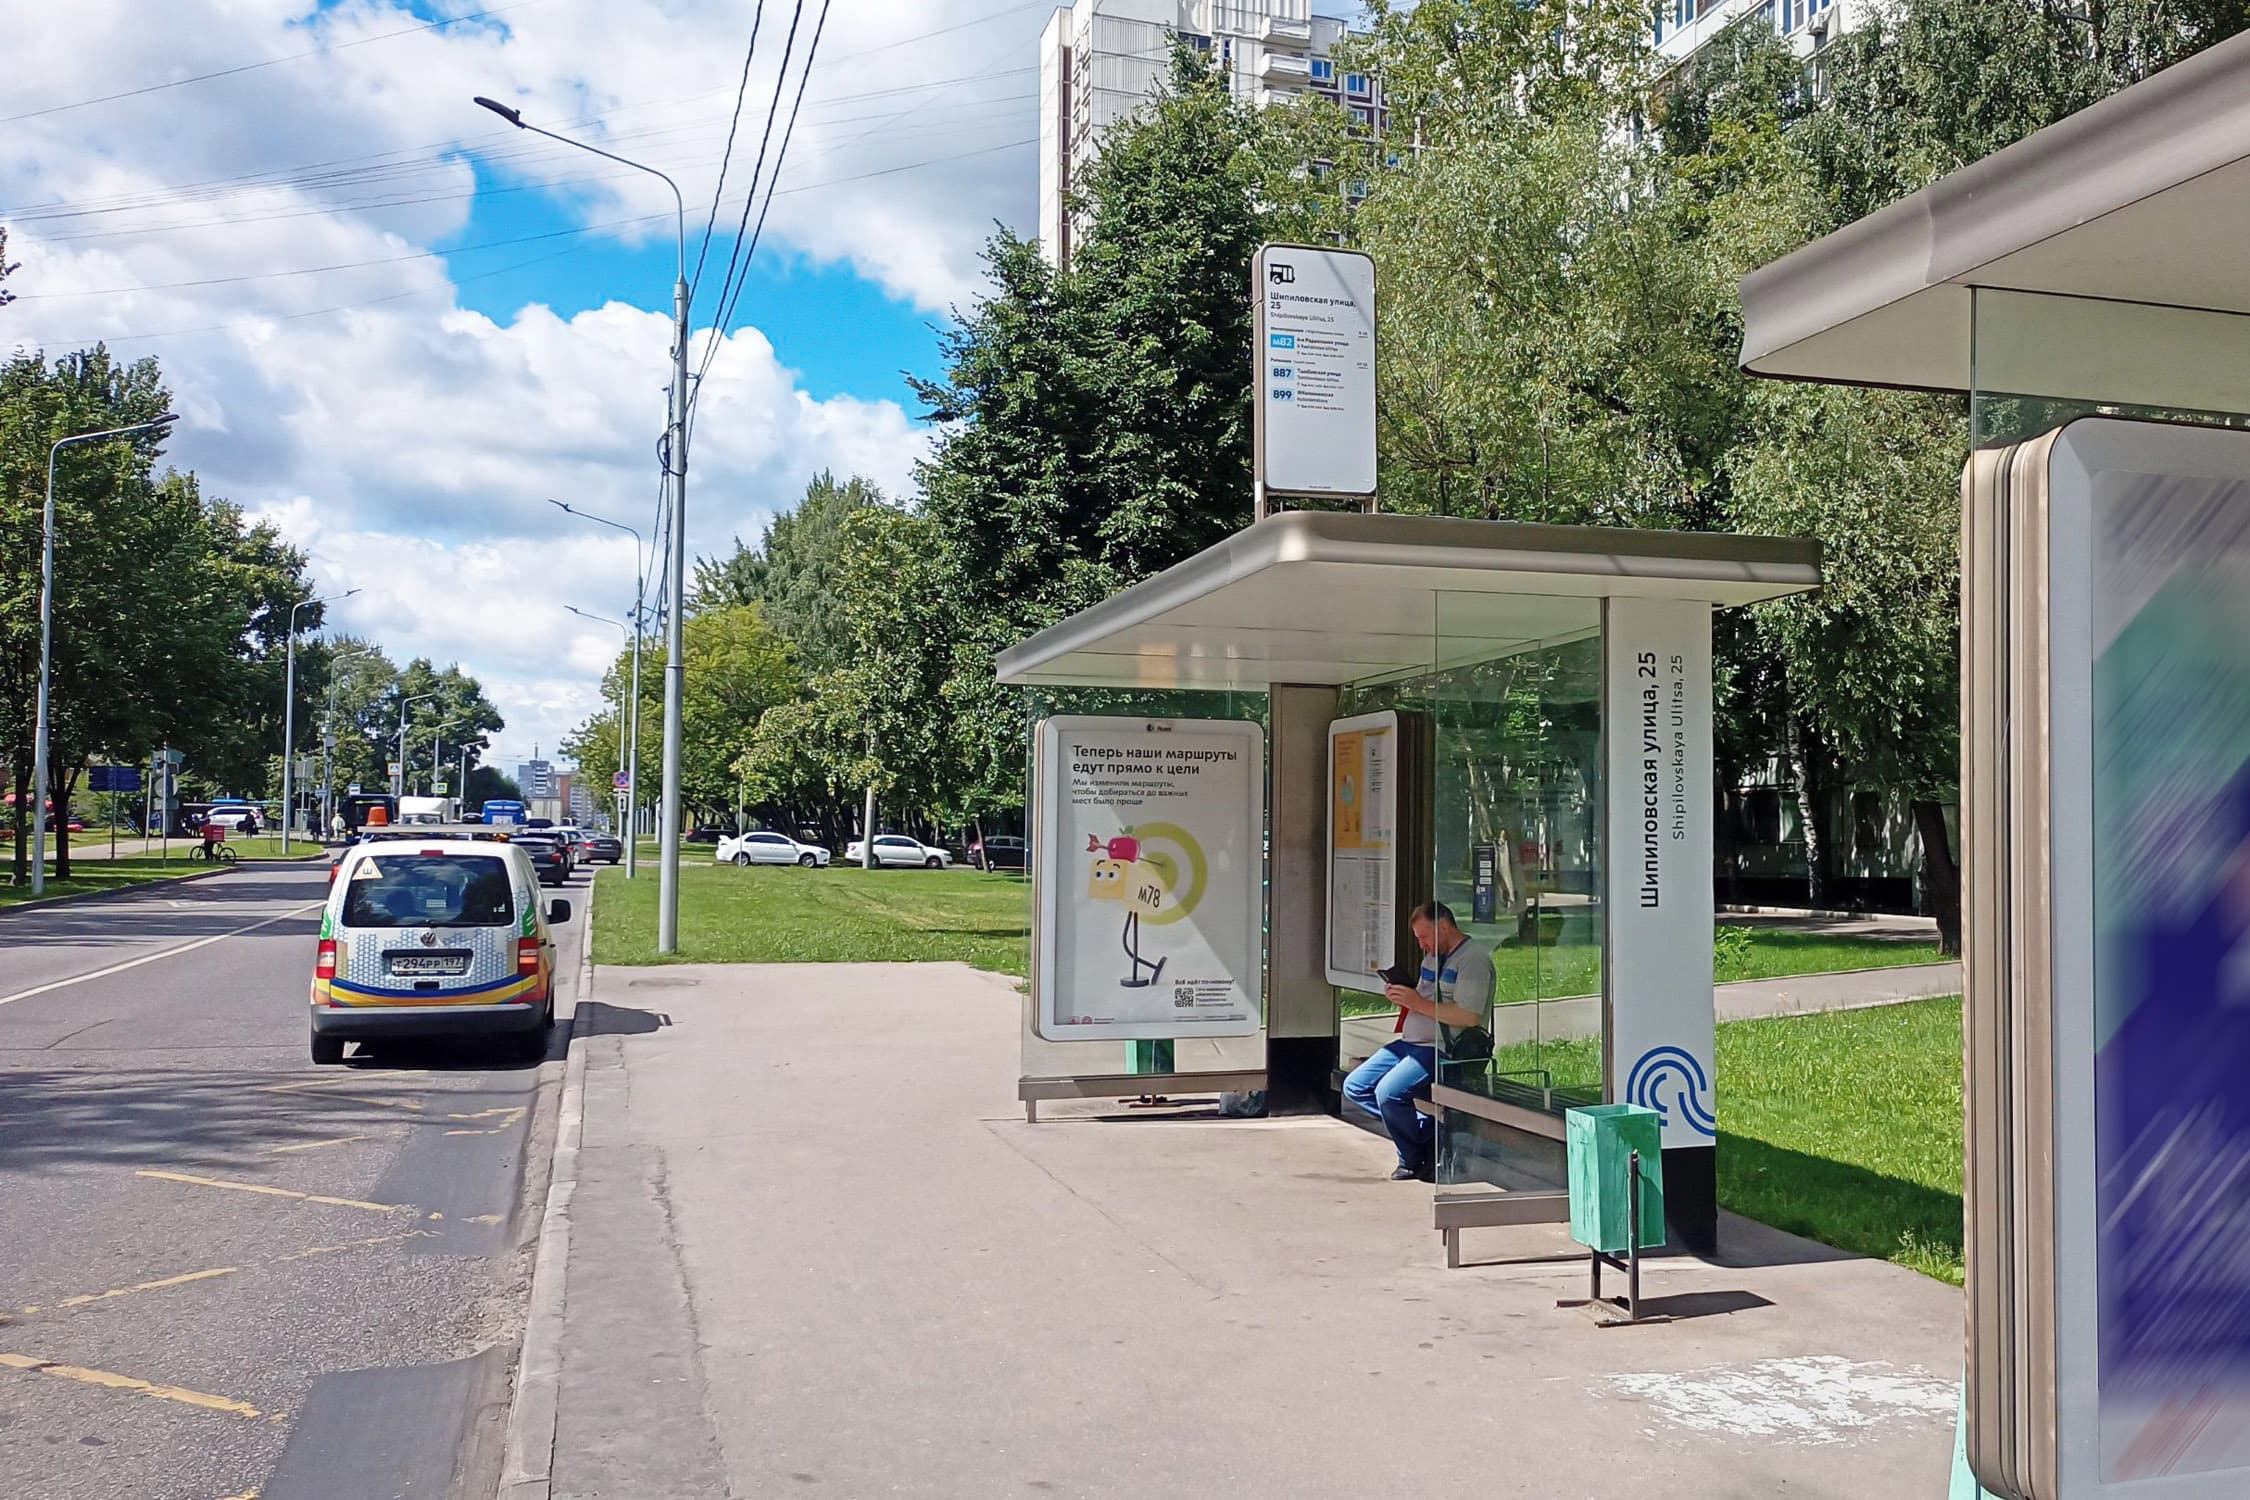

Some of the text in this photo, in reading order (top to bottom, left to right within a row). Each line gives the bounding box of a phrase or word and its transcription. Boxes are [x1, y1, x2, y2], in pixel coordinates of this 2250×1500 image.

[1270, 291, 1357, 308] Шипиловская улица,
[1270, 301, 1281, 309] 25
[1272, 368, 1292, 378] 887
[1273, 390, 1292, 399] 899
[1671, 655, 1687, 840] Shipilovskaya Ulitsa, 25
[1073, 745, 1237, 762] Теперь наши маршруты
[1073, 763, 1200, 775] едут прямо к цели
[1638, 652, 1661, 908] Шипиловская улица, 25
[1072, 788, 1097, 796] чтобы
[1098, 789, 1145, 797] добираться
[363, 867, 373, 875] Ш
[443, 957, 461, 966] 197
